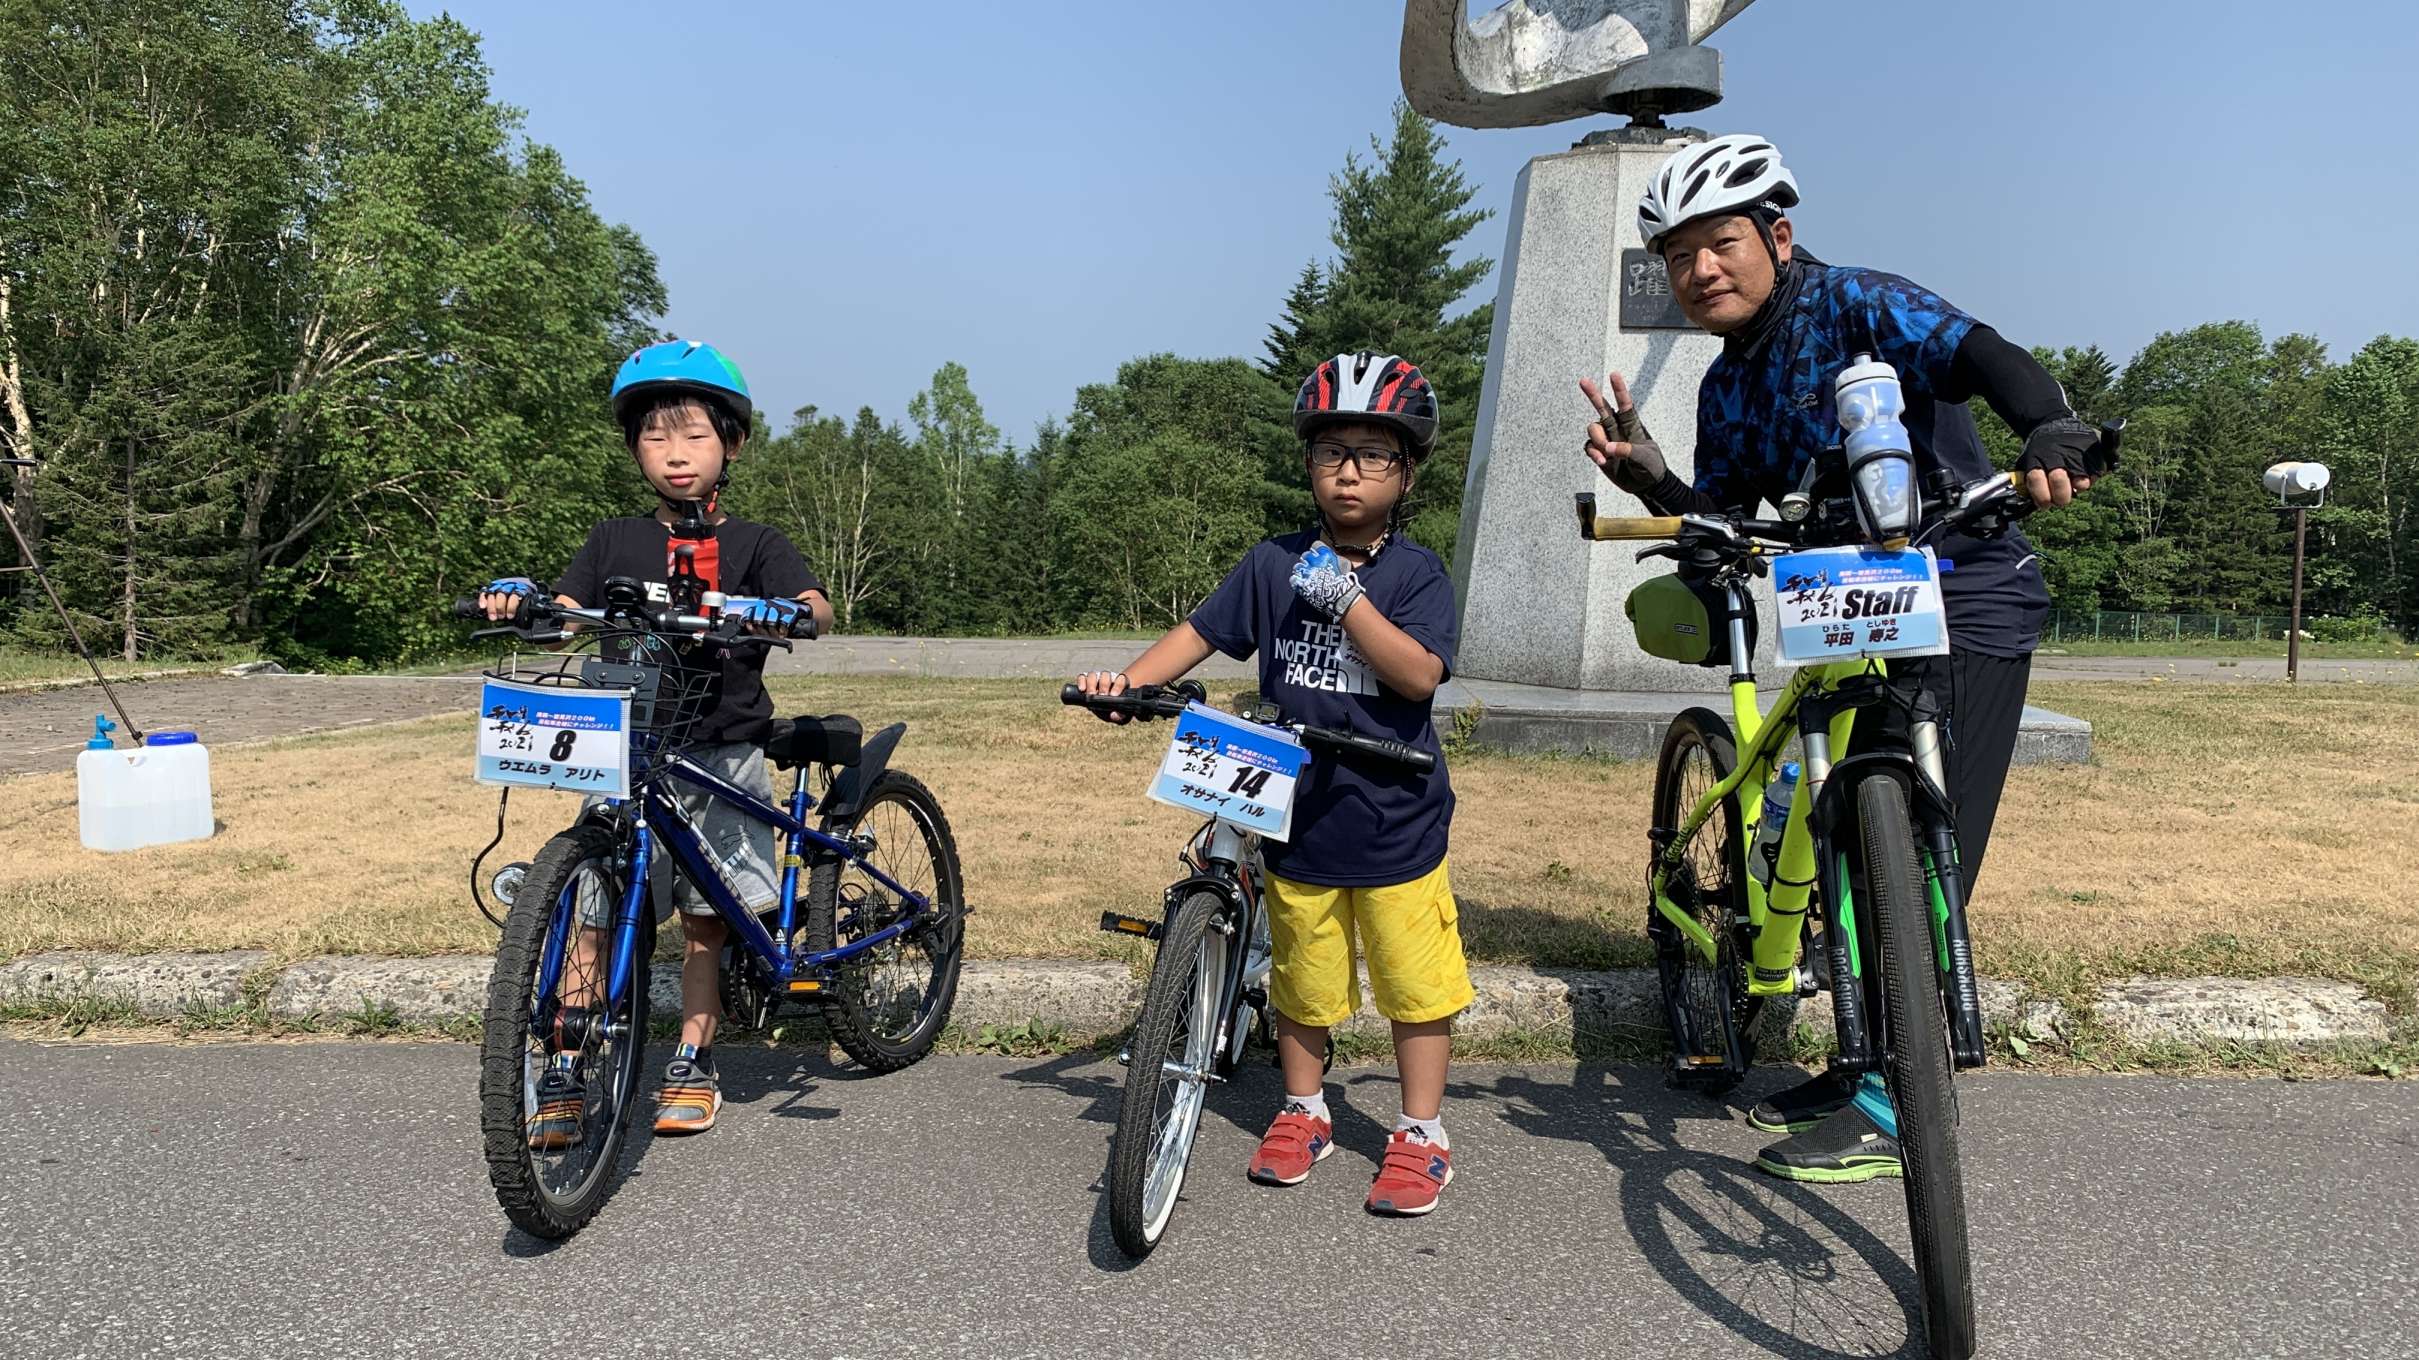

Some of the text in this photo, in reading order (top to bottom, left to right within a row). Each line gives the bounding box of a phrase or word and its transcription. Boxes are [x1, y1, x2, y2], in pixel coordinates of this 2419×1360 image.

[1841, 585, 1920, 620] Staff
[1301, 619, 1342, 646] THE
[1822, 624, 1850, 633] ひらた
[1824, 631, 1854, 647] 平田
[1274, 637, 1338, 669] NORTH
[1285, 662, 1336, 691] FACE
[549, 730, 577, 762] 8
[499, 760, 605, 781] ウエムラ アリト
[1228, 765, 1272, 799] 14
[1180, 783, 1265, 818] オサナイ ハル
[1953, 939, 1977, 1011] ROCKSHOX
